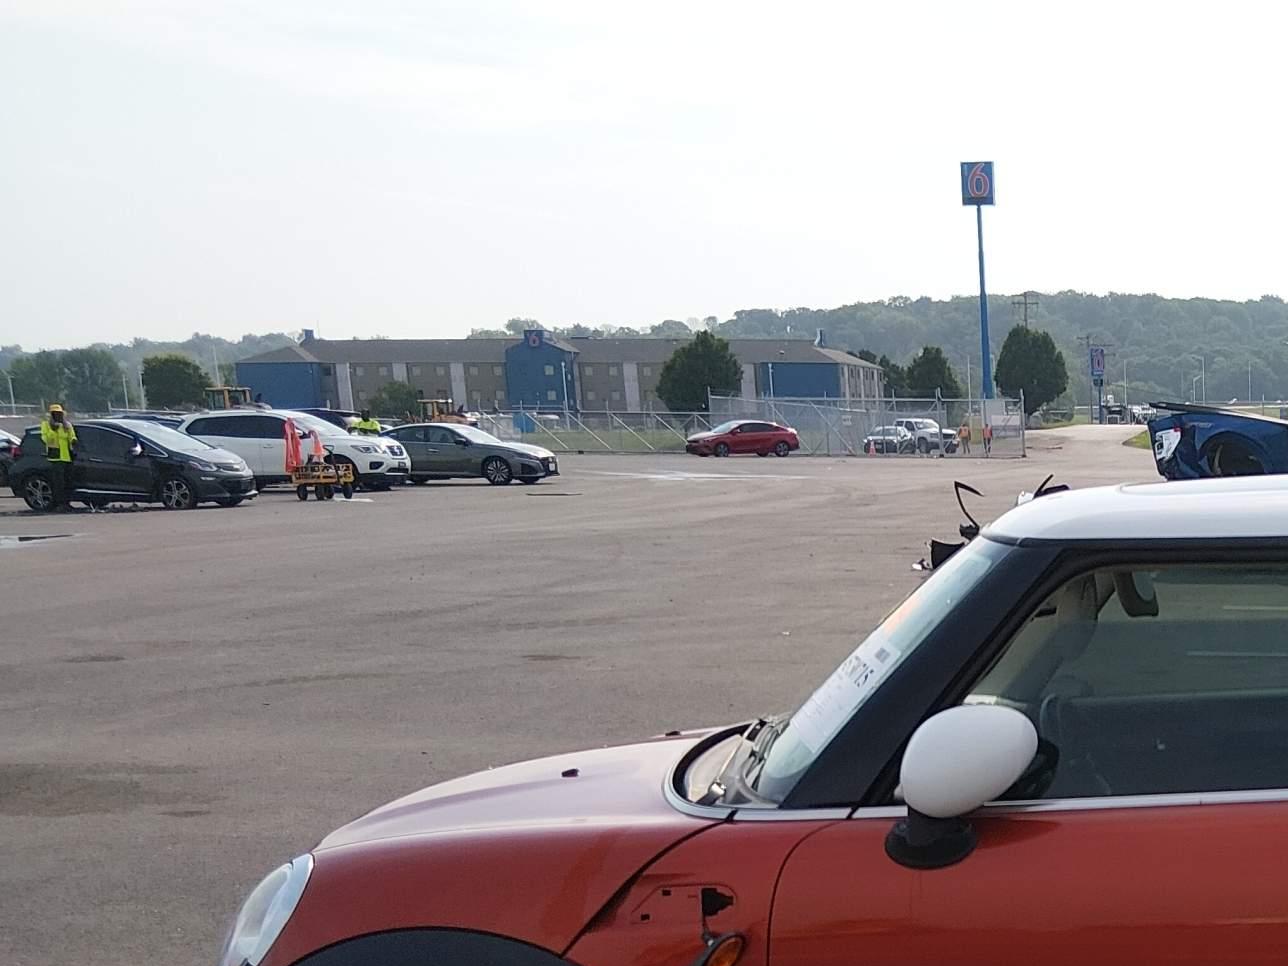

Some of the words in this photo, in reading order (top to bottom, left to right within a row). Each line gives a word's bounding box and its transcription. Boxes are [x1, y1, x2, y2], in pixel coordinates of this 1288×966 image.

[968, 162, 990, 198] 6
[527, 331, 540, 347] 6
[1093, 349, 1104, 370] 6
